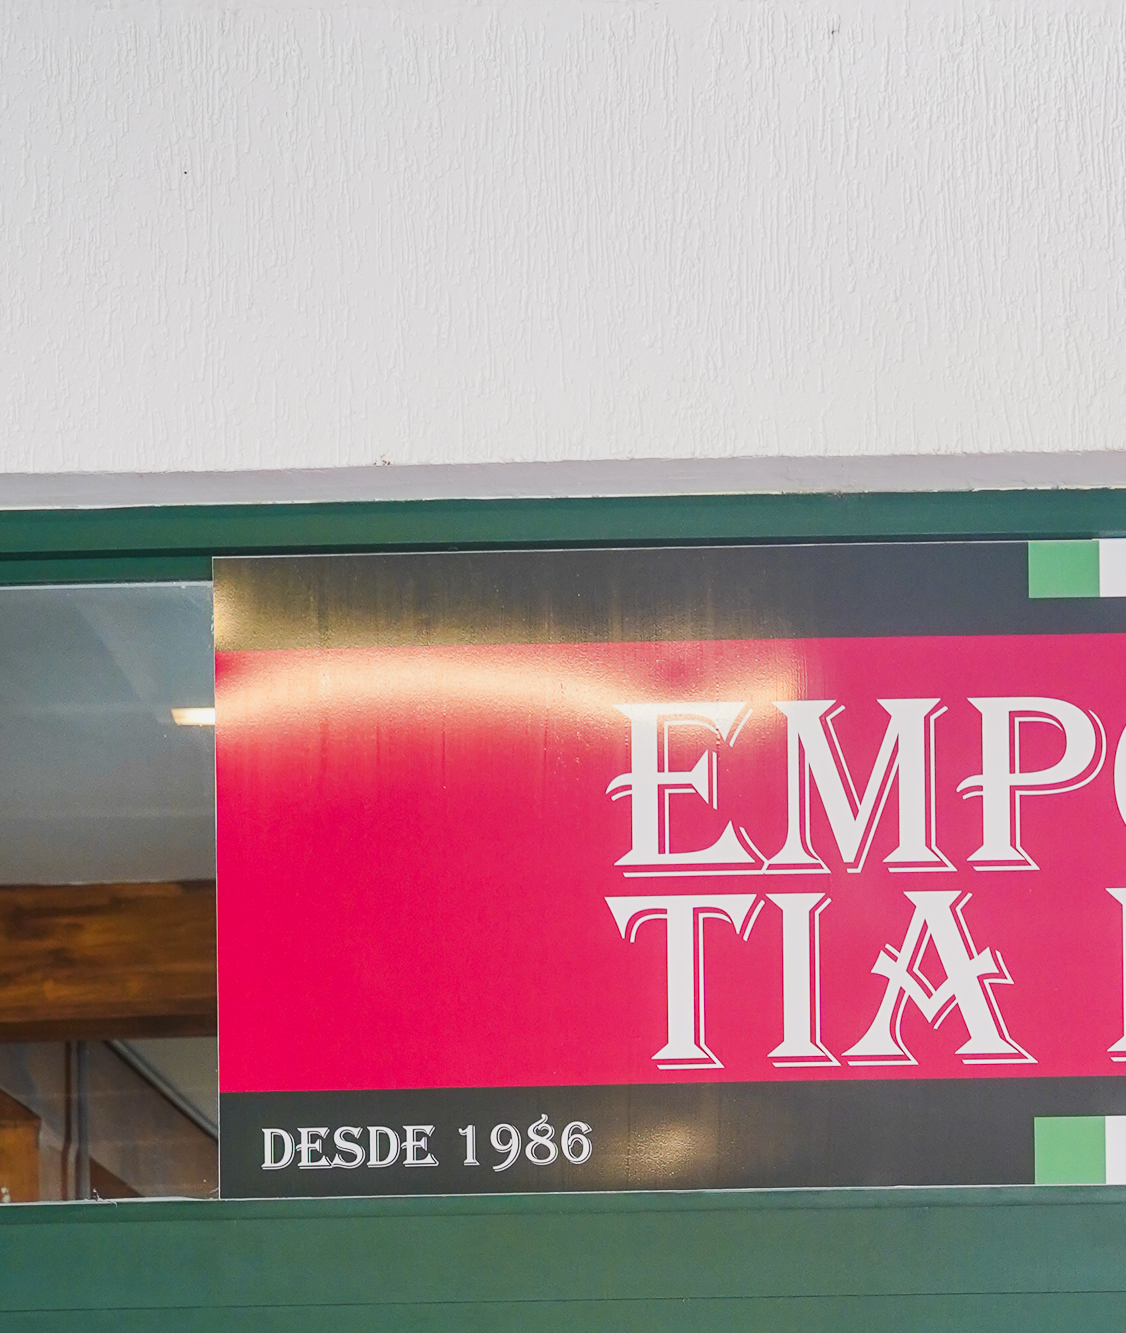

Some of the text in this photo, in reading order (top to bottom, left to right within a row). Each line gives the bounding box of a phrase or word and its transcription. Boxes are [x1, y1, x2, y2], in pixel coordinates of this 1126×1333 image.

[604, 888, 1038, 1070] TIA
[261, 1114, 593, 1172] DESDE 1986
